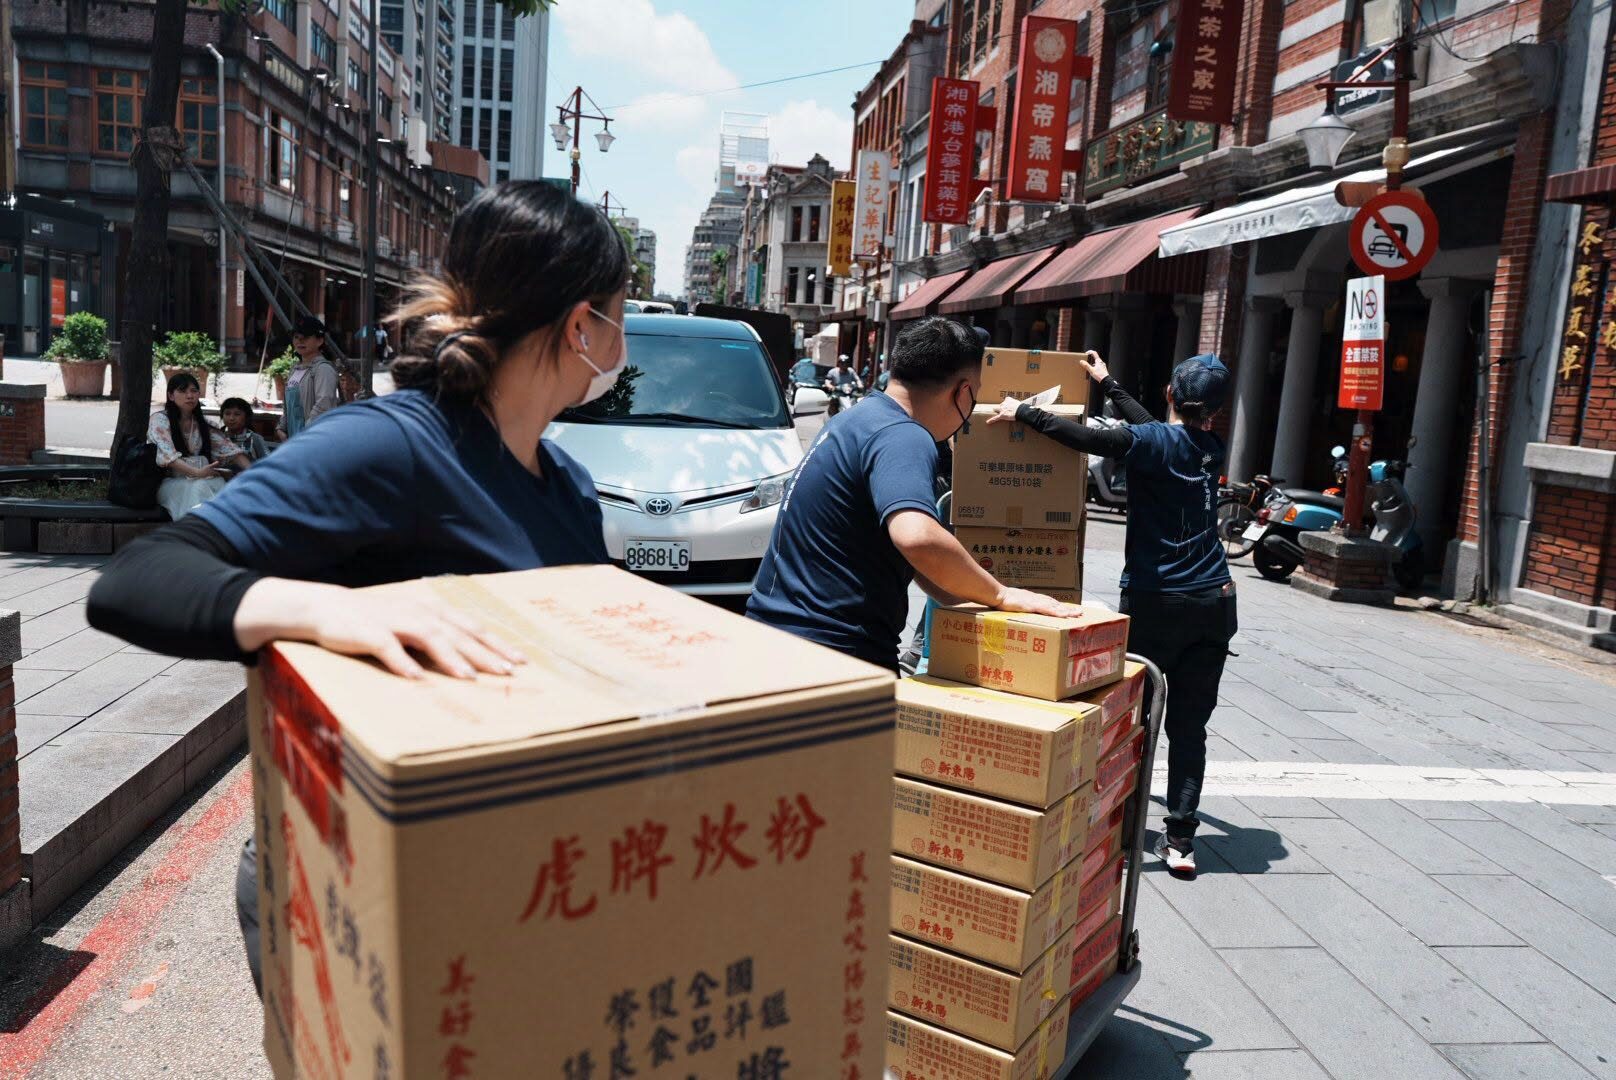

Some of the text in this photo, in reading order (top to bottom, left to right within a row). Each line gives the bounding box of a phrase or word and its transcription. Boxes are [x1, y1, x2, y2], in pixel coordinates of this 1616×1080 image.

[1024, 69, 1060, 193] 湘帝燕窩
[981, 665, 1014, 683] 新東陽
[938, 761, 976, 781] 新東陽
[519, 792, 827, 924] 虎牌炊粉
[928, 840, 965, 862] 新東陽
[918, 919, 955, 941] 新東陽
[911, 996, 948, 1019] 新東陽
